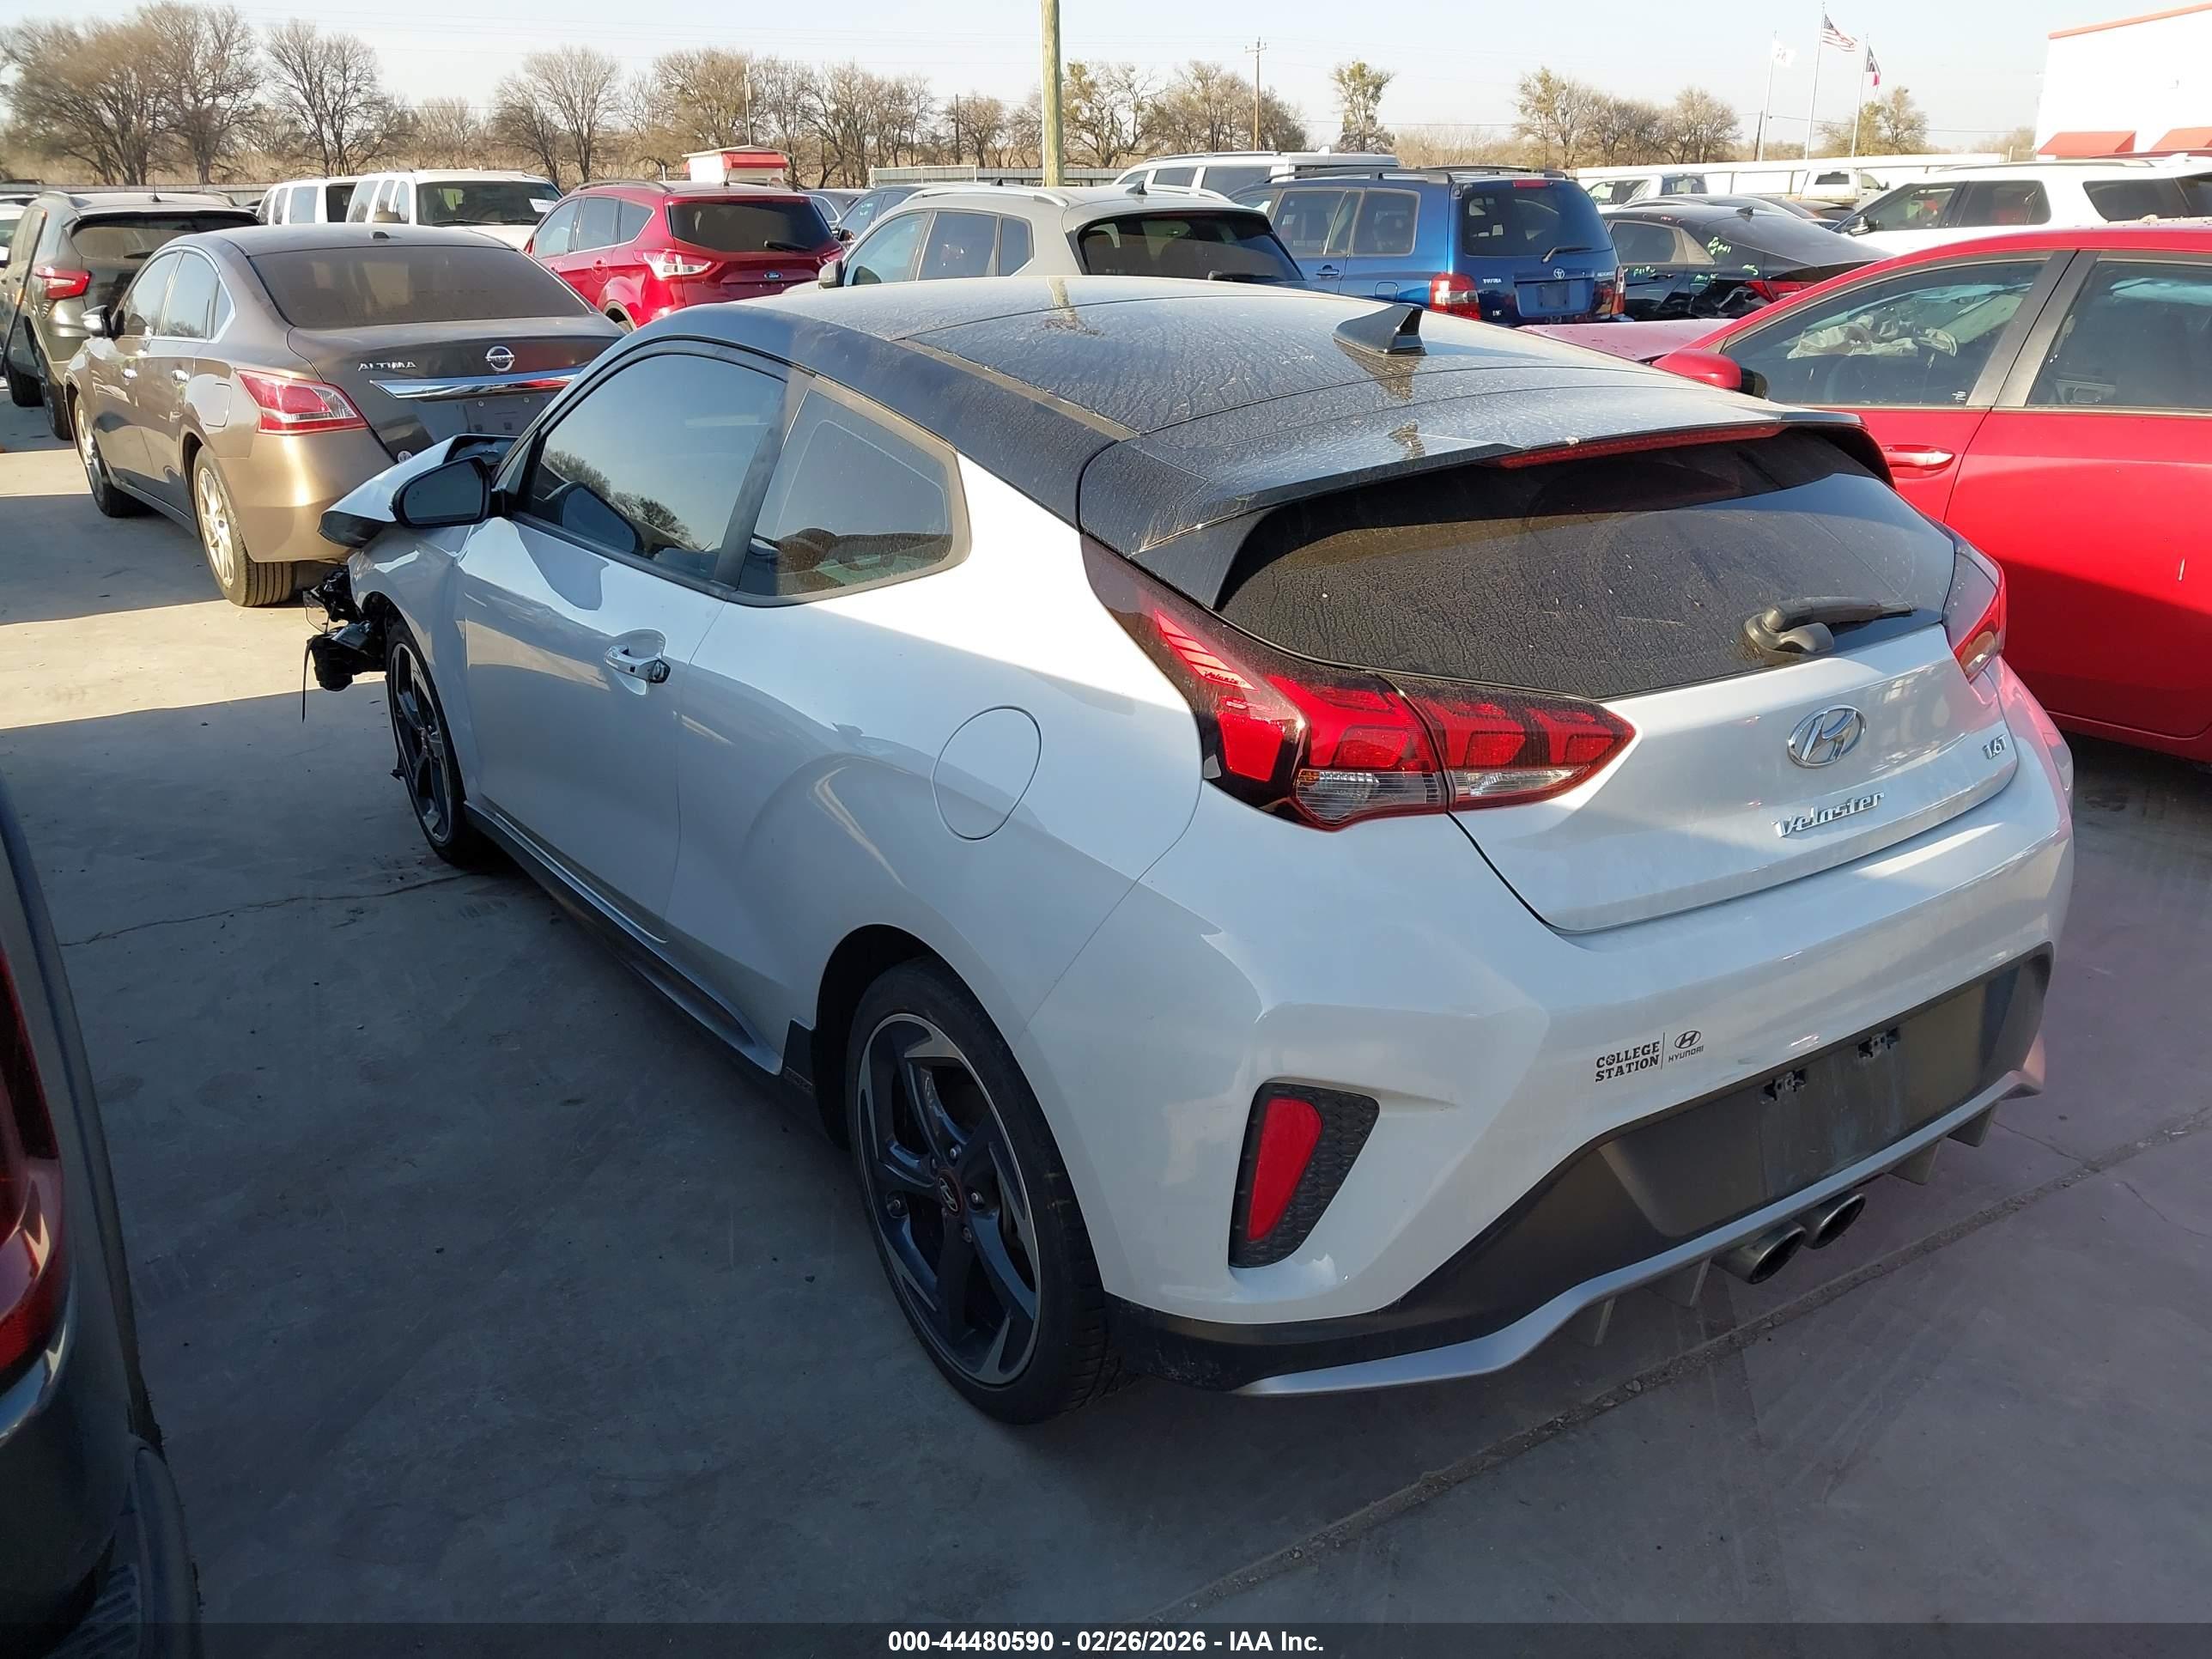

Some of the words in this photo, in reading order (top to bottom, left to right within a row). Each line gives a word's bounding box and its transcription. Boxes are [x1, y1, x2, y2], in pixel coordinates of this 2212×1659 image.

[358, 361, 417, 371] ALTIMA
[1982, 734, 2007, 760] 1.6T
[1771, 791, 1885, 838] Veloster
[1595, 1041, 1660, 1068] COLLEGE
[1668, 1045, 1705, 1063] HYUNDAI
[1595, 1054, 1660, 1083] STATION
